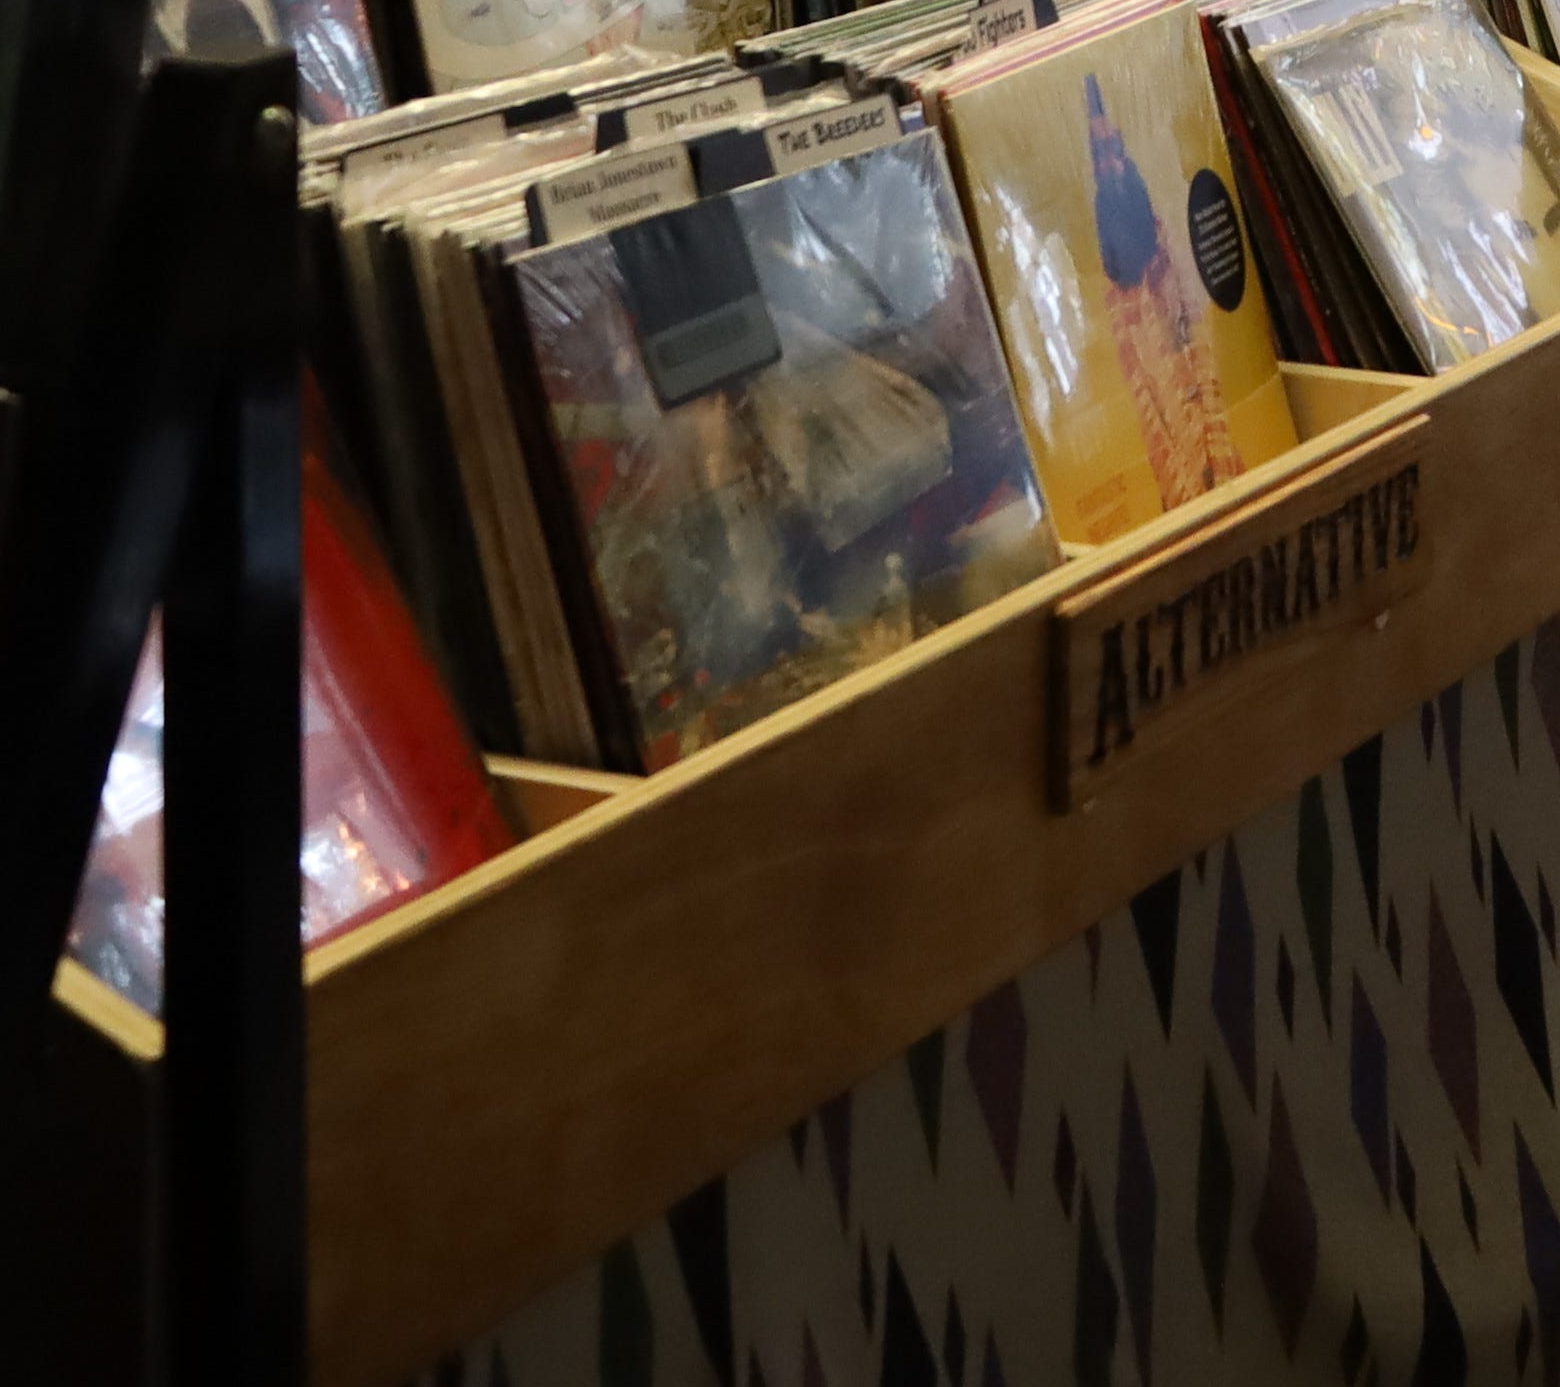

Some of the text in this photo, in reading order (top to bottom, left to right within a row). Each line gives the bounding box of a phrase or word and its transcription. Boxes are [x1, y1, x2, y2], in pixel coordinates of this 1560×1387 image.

[978, 8, 1027, 48] Fighters
[775, 103, 889, 159] THE BREEDERS
[1087, 460, 1421, 767] ALTERNATIVE
